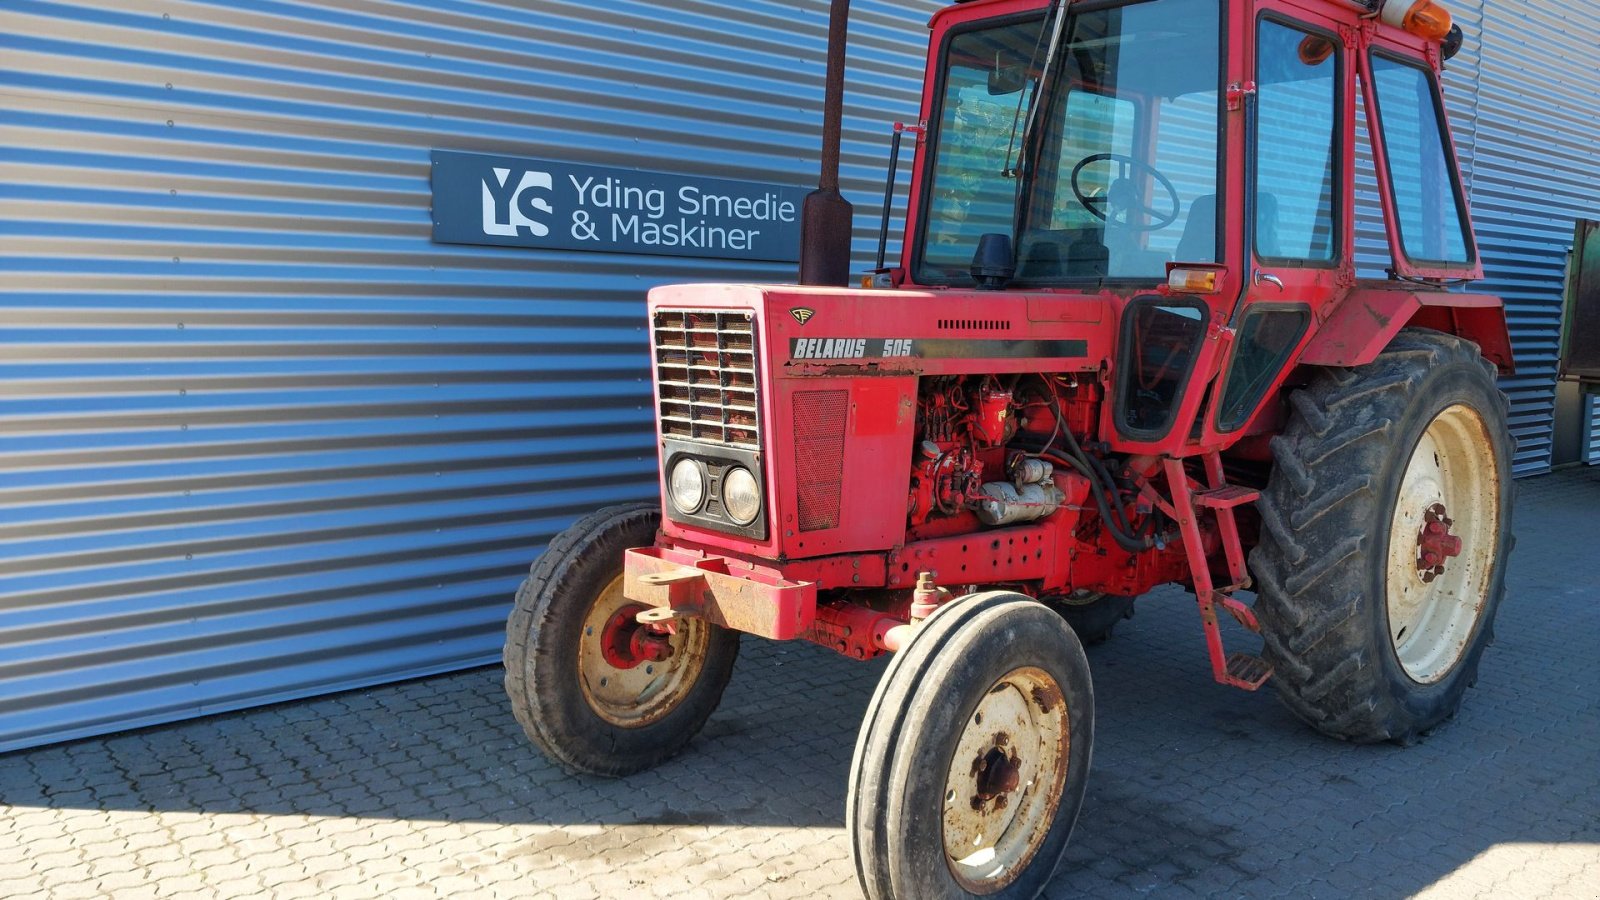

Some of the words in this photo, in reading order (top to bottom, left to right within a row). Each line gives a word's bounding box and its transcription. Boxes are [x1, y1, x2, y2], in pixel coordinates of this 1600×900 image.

[568, 174, 665, 218] Yding
[678, 186, 796, 222] Smedie
[570, 210, 600, 241] &
[611, 213, 760, 250] Maskiner
[793, 338, 866, 359] BELARUS
[882, 338, 913, 357] 505
